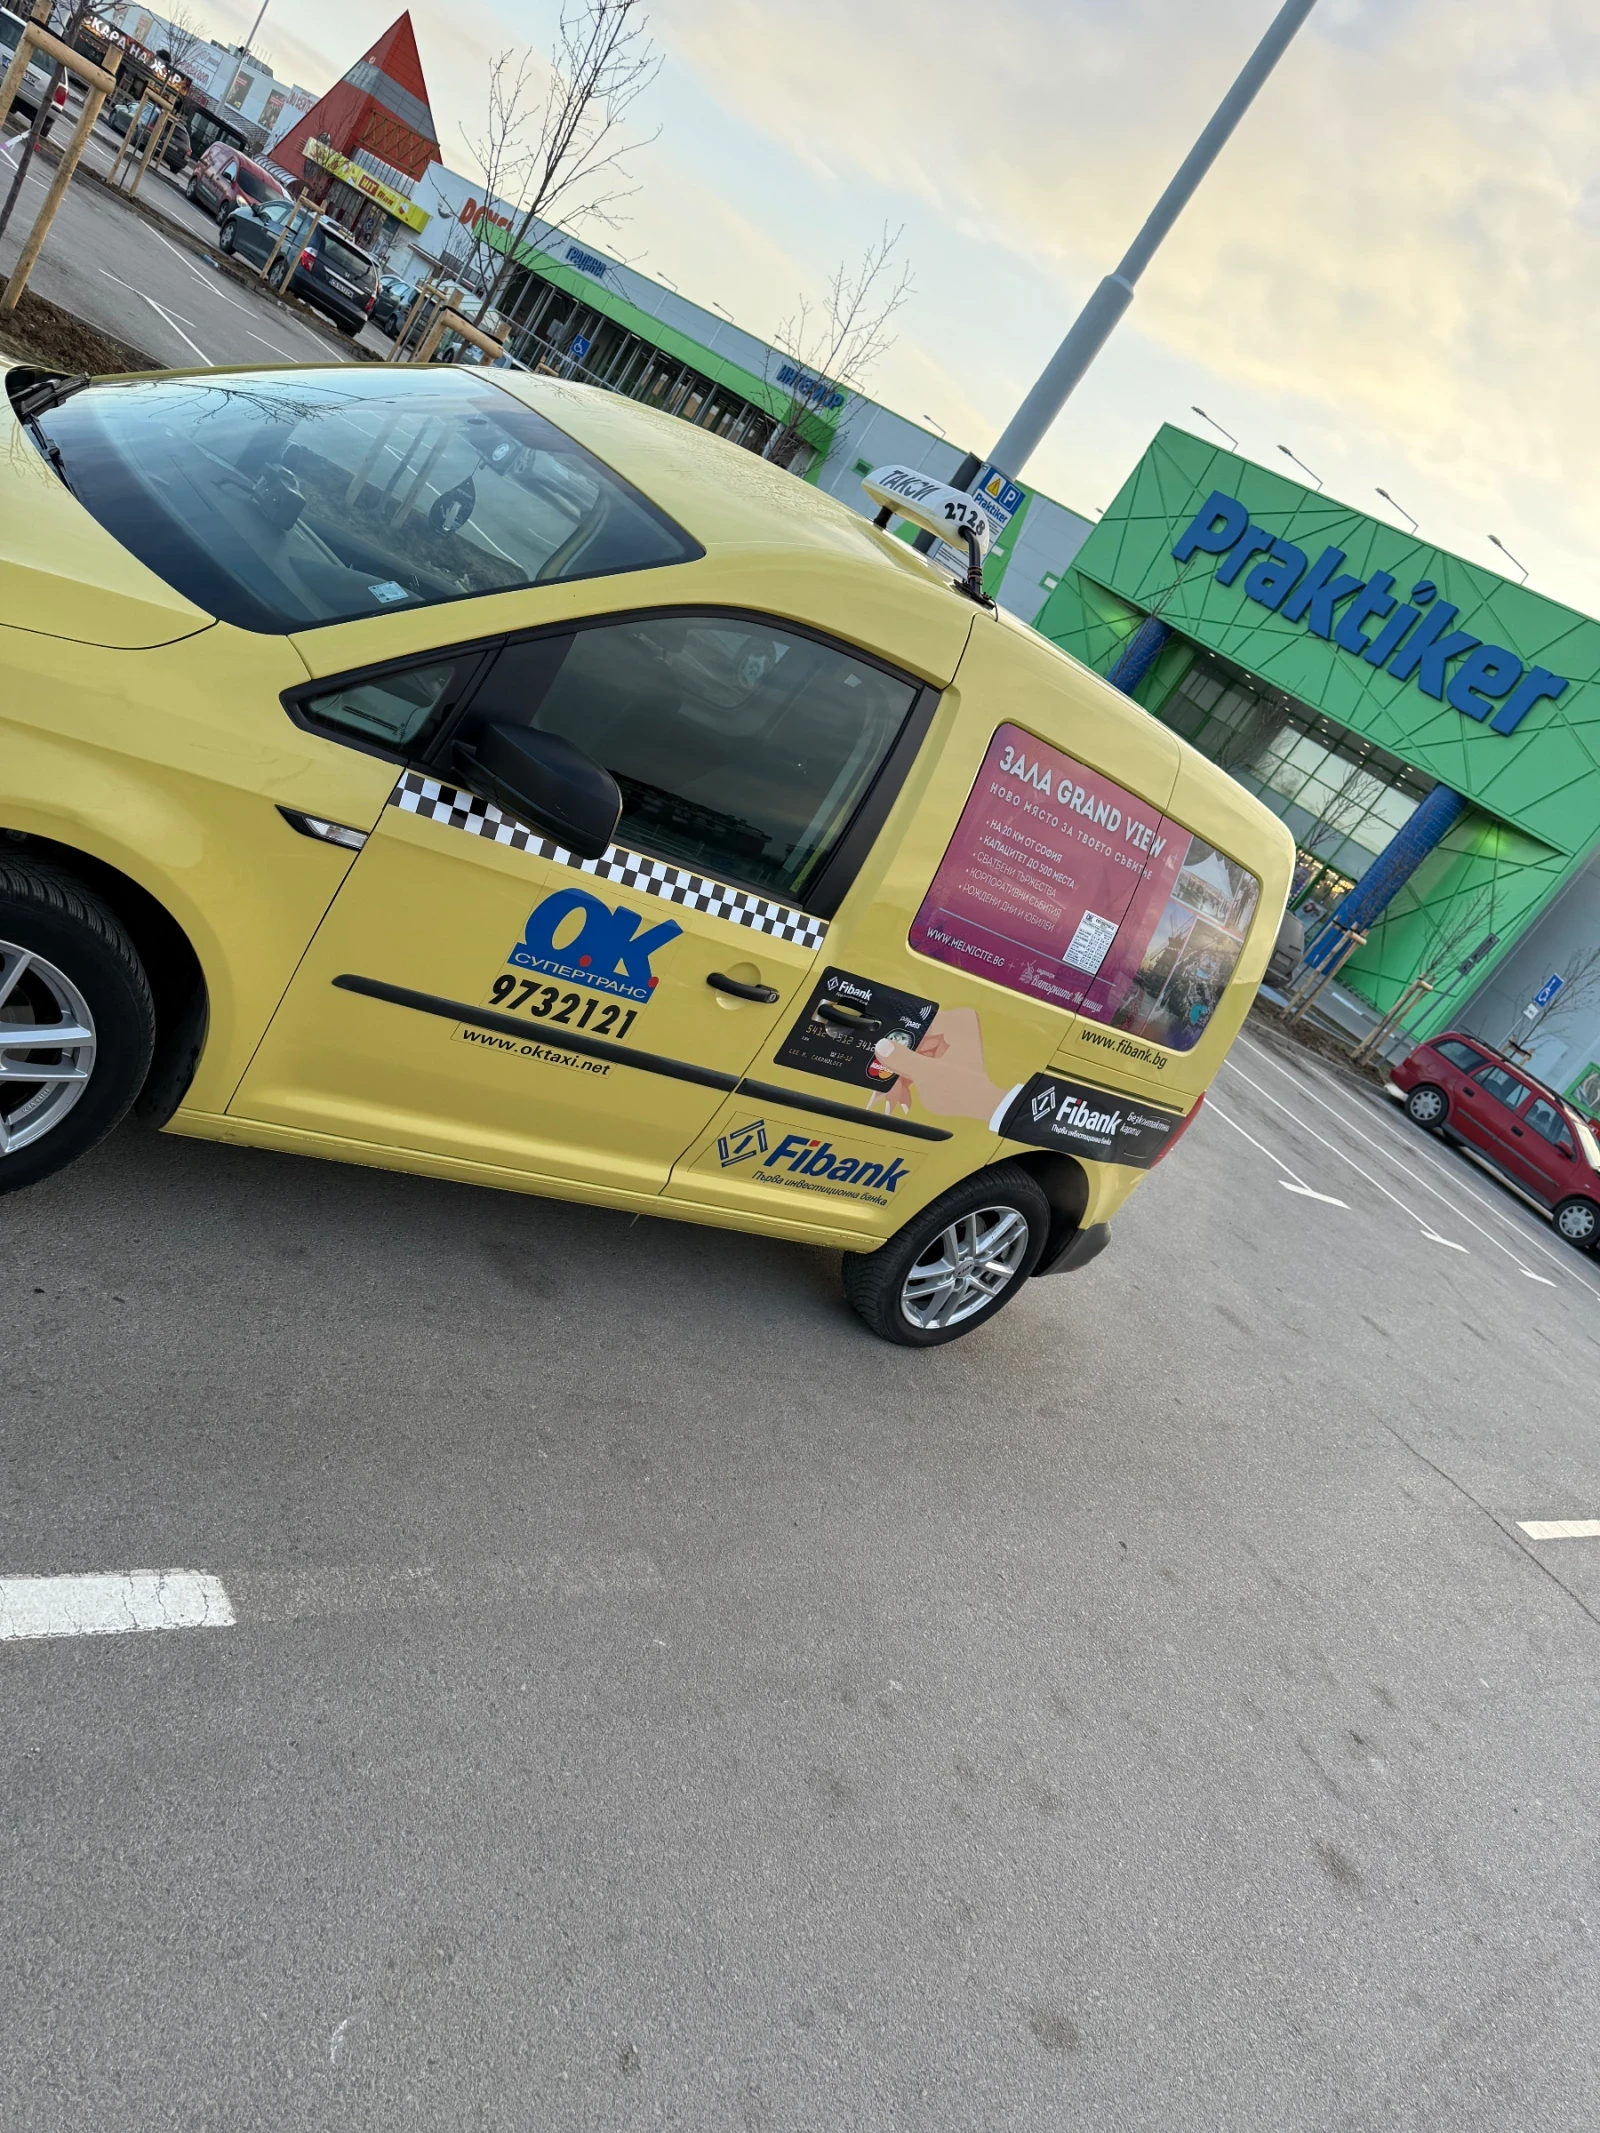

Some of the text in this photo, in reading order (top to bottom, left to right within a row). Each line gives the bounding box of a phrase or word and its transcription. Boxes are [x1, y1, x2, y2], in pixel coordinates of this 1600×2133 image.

[129, 45, 147, 65] НА
[361, 178, 377, 193] HIT
[879, 469, 942, 502] ТАКСИ
[944, 502, 986, 536] 2728
[972, 490, 1009, 525] Praktiker
[1171, 489, 1570, 737] Praktiker
[989, 782, 1021, 806] НОВО
[1023, 801, 1059, 828] МЯСТО
[1060, 822, 1074, 837] ЗА
[1076, 830, 1113, 858] ТВОЕТО
[1000, 745, 1168, 859] ЗАЛА GRAND VIEW
[983, 835, 1076, 889] КАПАЦИТЕТ ДО 500 МЕСТА
[990, 819, 1063, 864] НА 20 КМ ОТ СОФИЯ
[969, 867, 1063, 919] КОРПОРАТИВНИ СЪБИТИЯ
[976, 851, 1057, 898] СВАТБЕНИ ТЪРЖЕСТВА
[962, 883, 1001, 907] РОЖДЕНИ
[1000, 901, 1018, 915] ДНИ
[1017, 907, 1024, 918] И
[926, 926, 1006, 968] WWW.MELNICITE.BG
[514, 951, 648, 1000] СУПЕРТРАНС
[838, 980, 873, 1002] Fibank
[488, 974, 638, 1040] 9732121
[463, 1028, 611, 1076] www.oktaxi.net
[805, 1024, 828, 1039] 5412
[1081, 1028, 1169, 1070] www.fibank.bg
[1055, 1095, 1122, 1137] Fibank
[1119, 1123, 1142, 1138] карти
[762, 1134, 911, 1193] Fibank
[752, 1170, 888, 1207] Първа инвестиционна банка
